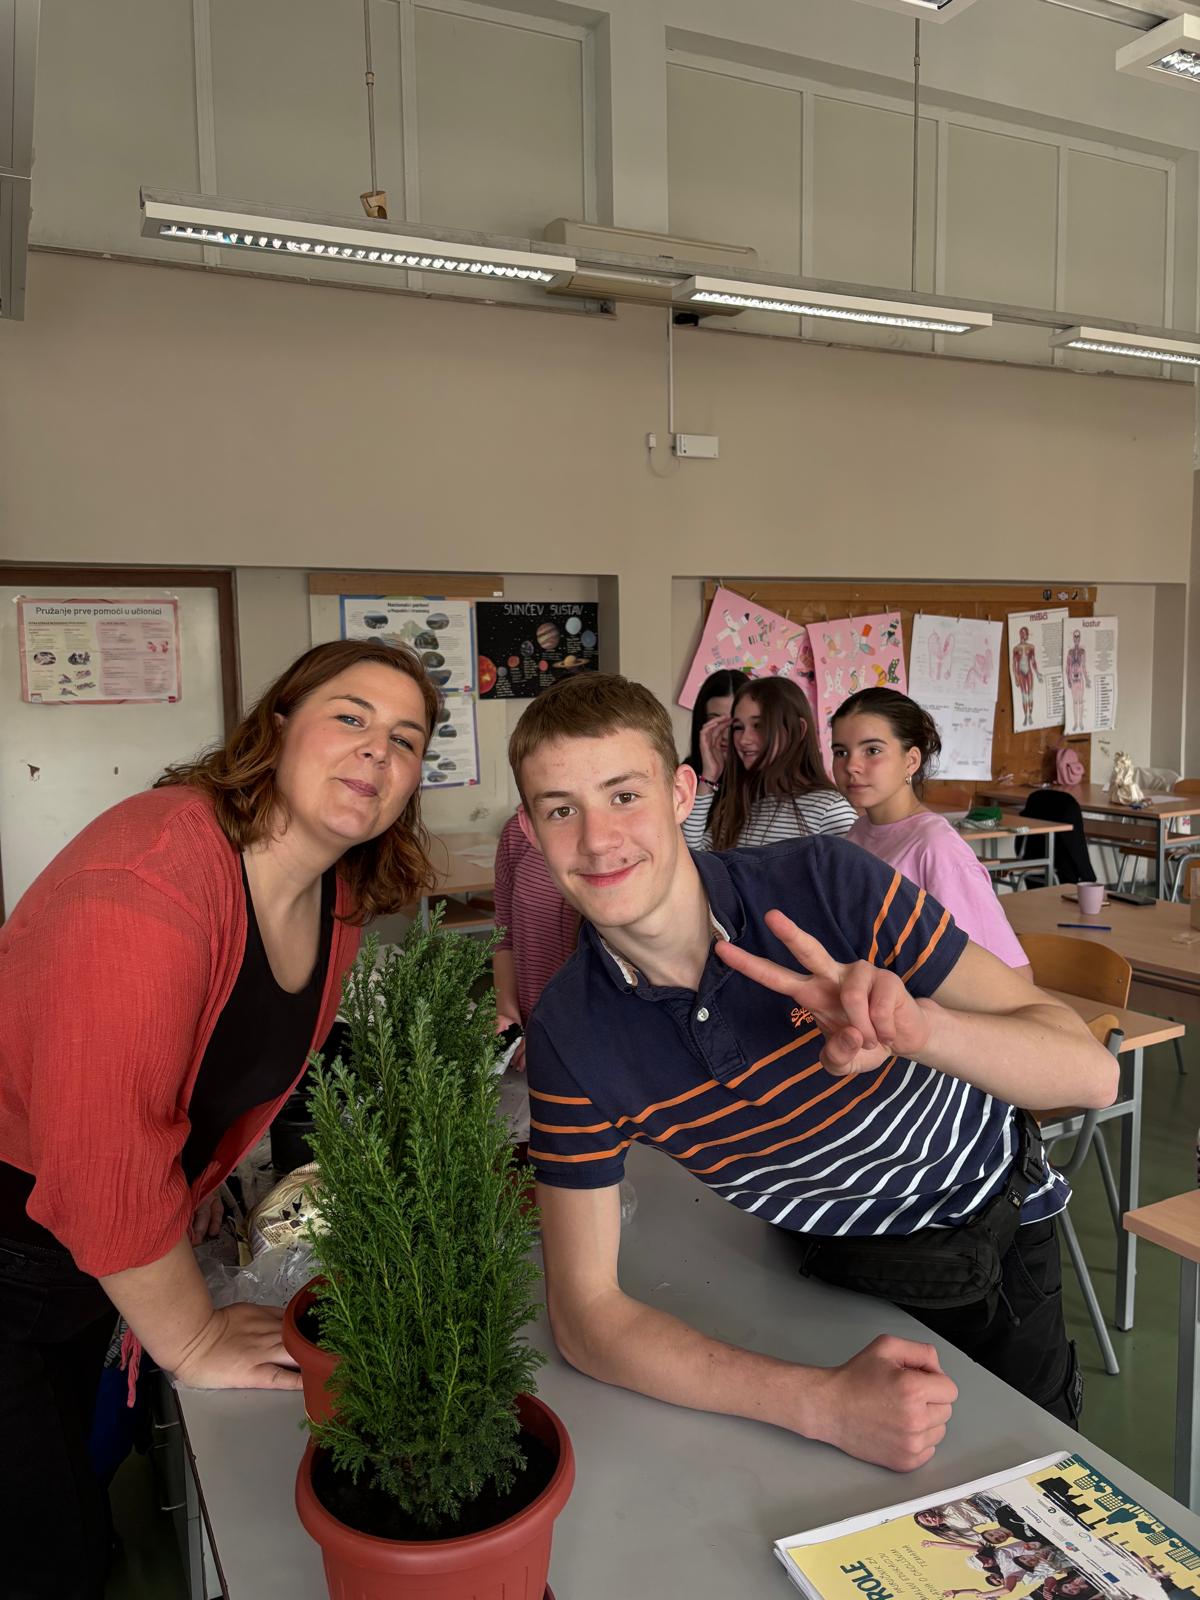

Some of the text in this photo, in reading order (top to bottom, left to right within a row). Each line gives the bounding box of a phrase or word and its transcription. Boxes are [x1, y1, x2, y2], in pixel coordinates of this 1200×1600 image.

[35, 606, 72, 617] Pružanje
[73, 608, 92, 616] prve
[93, 606, 124, 616] pomoći
[131, 606, 162, 616] učionici
[503, 603, 584, 616] SUNČEV SUSTAV
